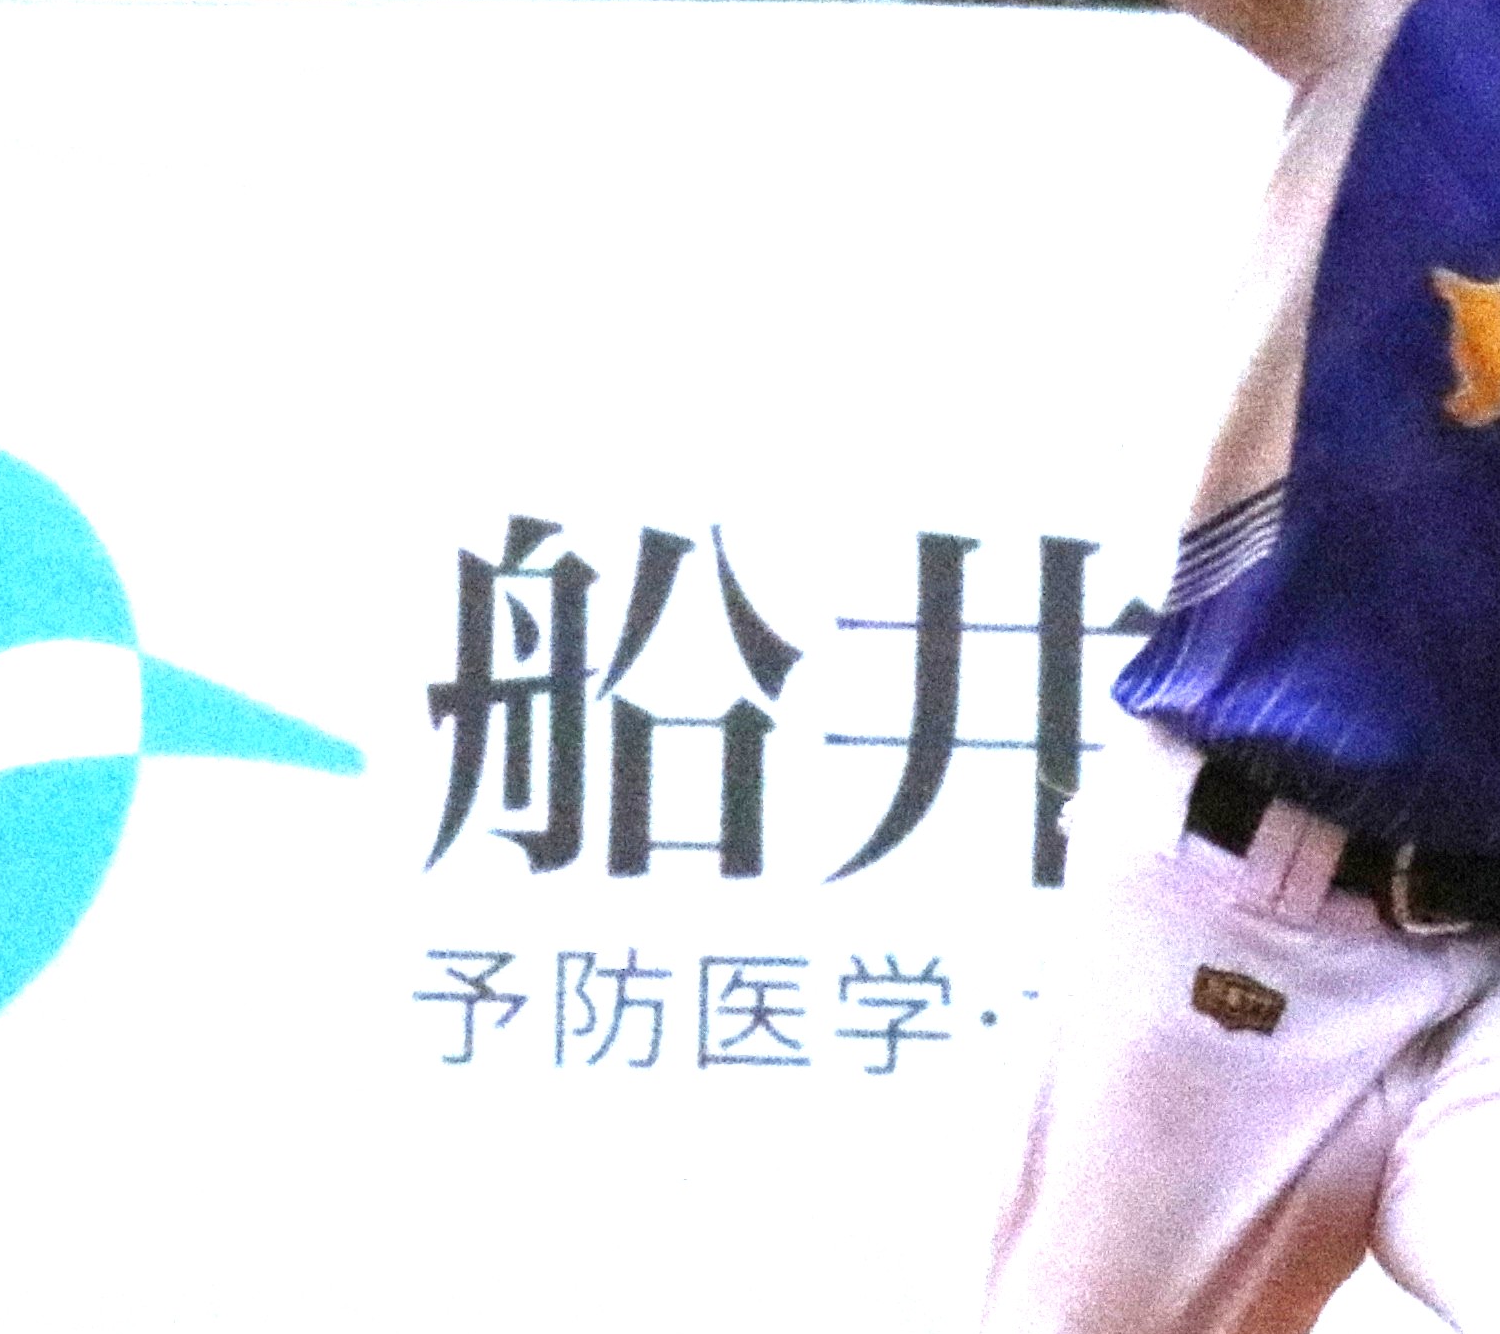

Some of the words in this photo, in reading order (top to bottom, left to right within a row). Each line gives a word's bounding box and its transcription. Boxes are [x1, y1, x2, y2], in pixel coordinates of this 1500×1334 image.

[412, 948, 1039, 1076] 予防医学・
